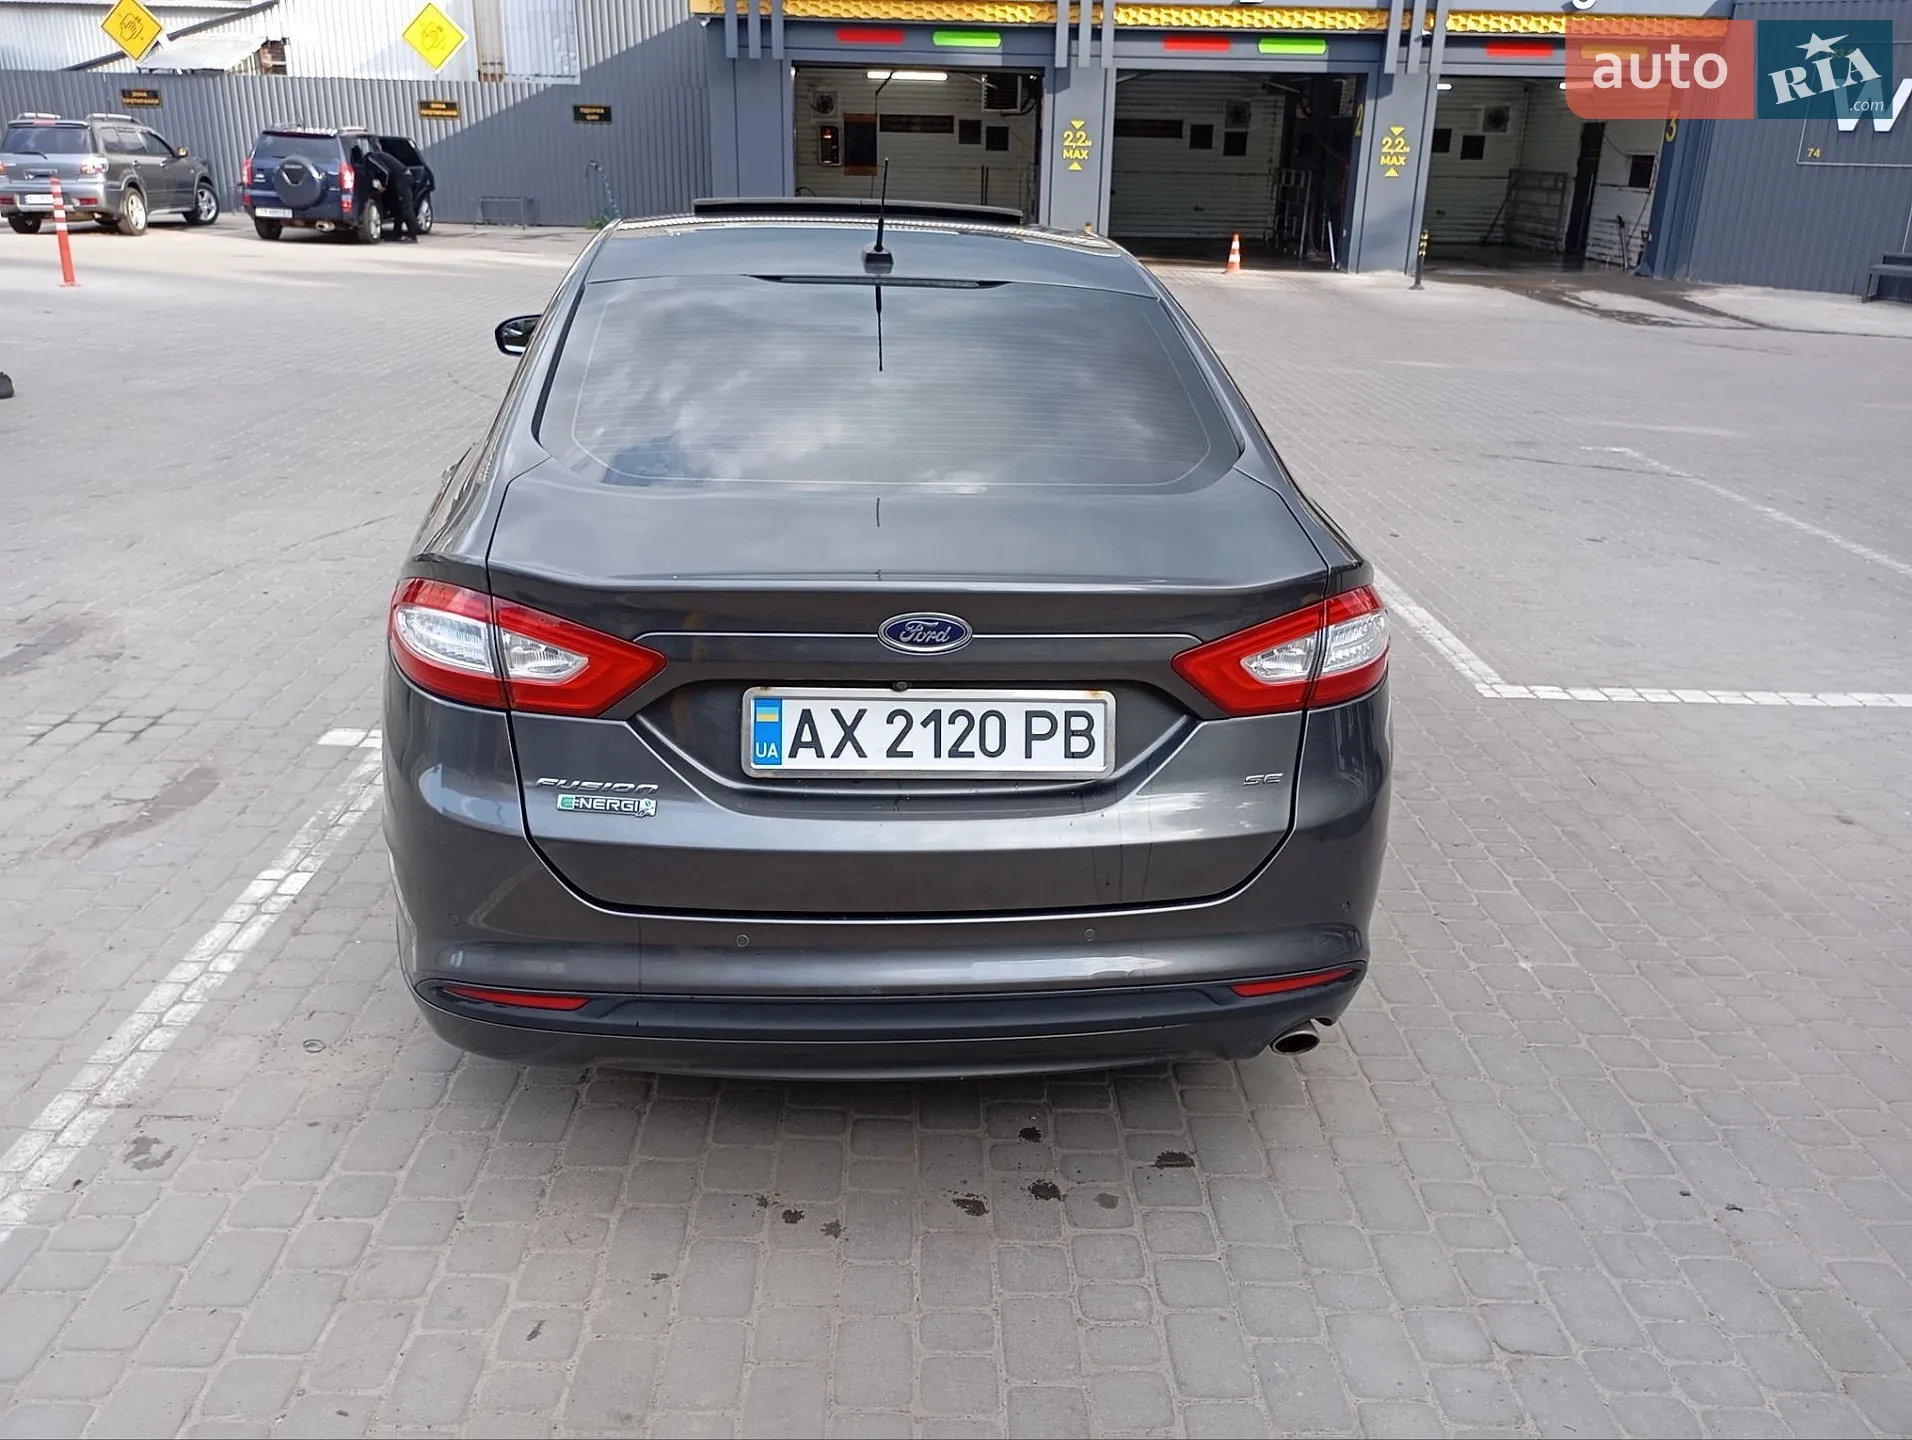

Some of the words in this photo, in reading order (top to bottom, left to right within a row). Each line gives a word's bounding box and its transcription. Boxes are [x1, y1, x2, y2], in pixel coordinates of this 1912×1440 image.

[1354, 103, 1364, 136] 2
[1063, 149, 1089, 160] MAX
[1380, 155, 1406, 166] MAX
[1807, 147, 1821, 159] 74
[899, 620, 952, 643] Ford
[788, 708, 868, 759] AX
[885, 708, 1008, 759] 2120
[1024, 709, 1096, 759] PB
[755, 741, 779, 759] UA
[535, 777, 659, 795] FUSION
[1243, 772, 1284, 786] SE
